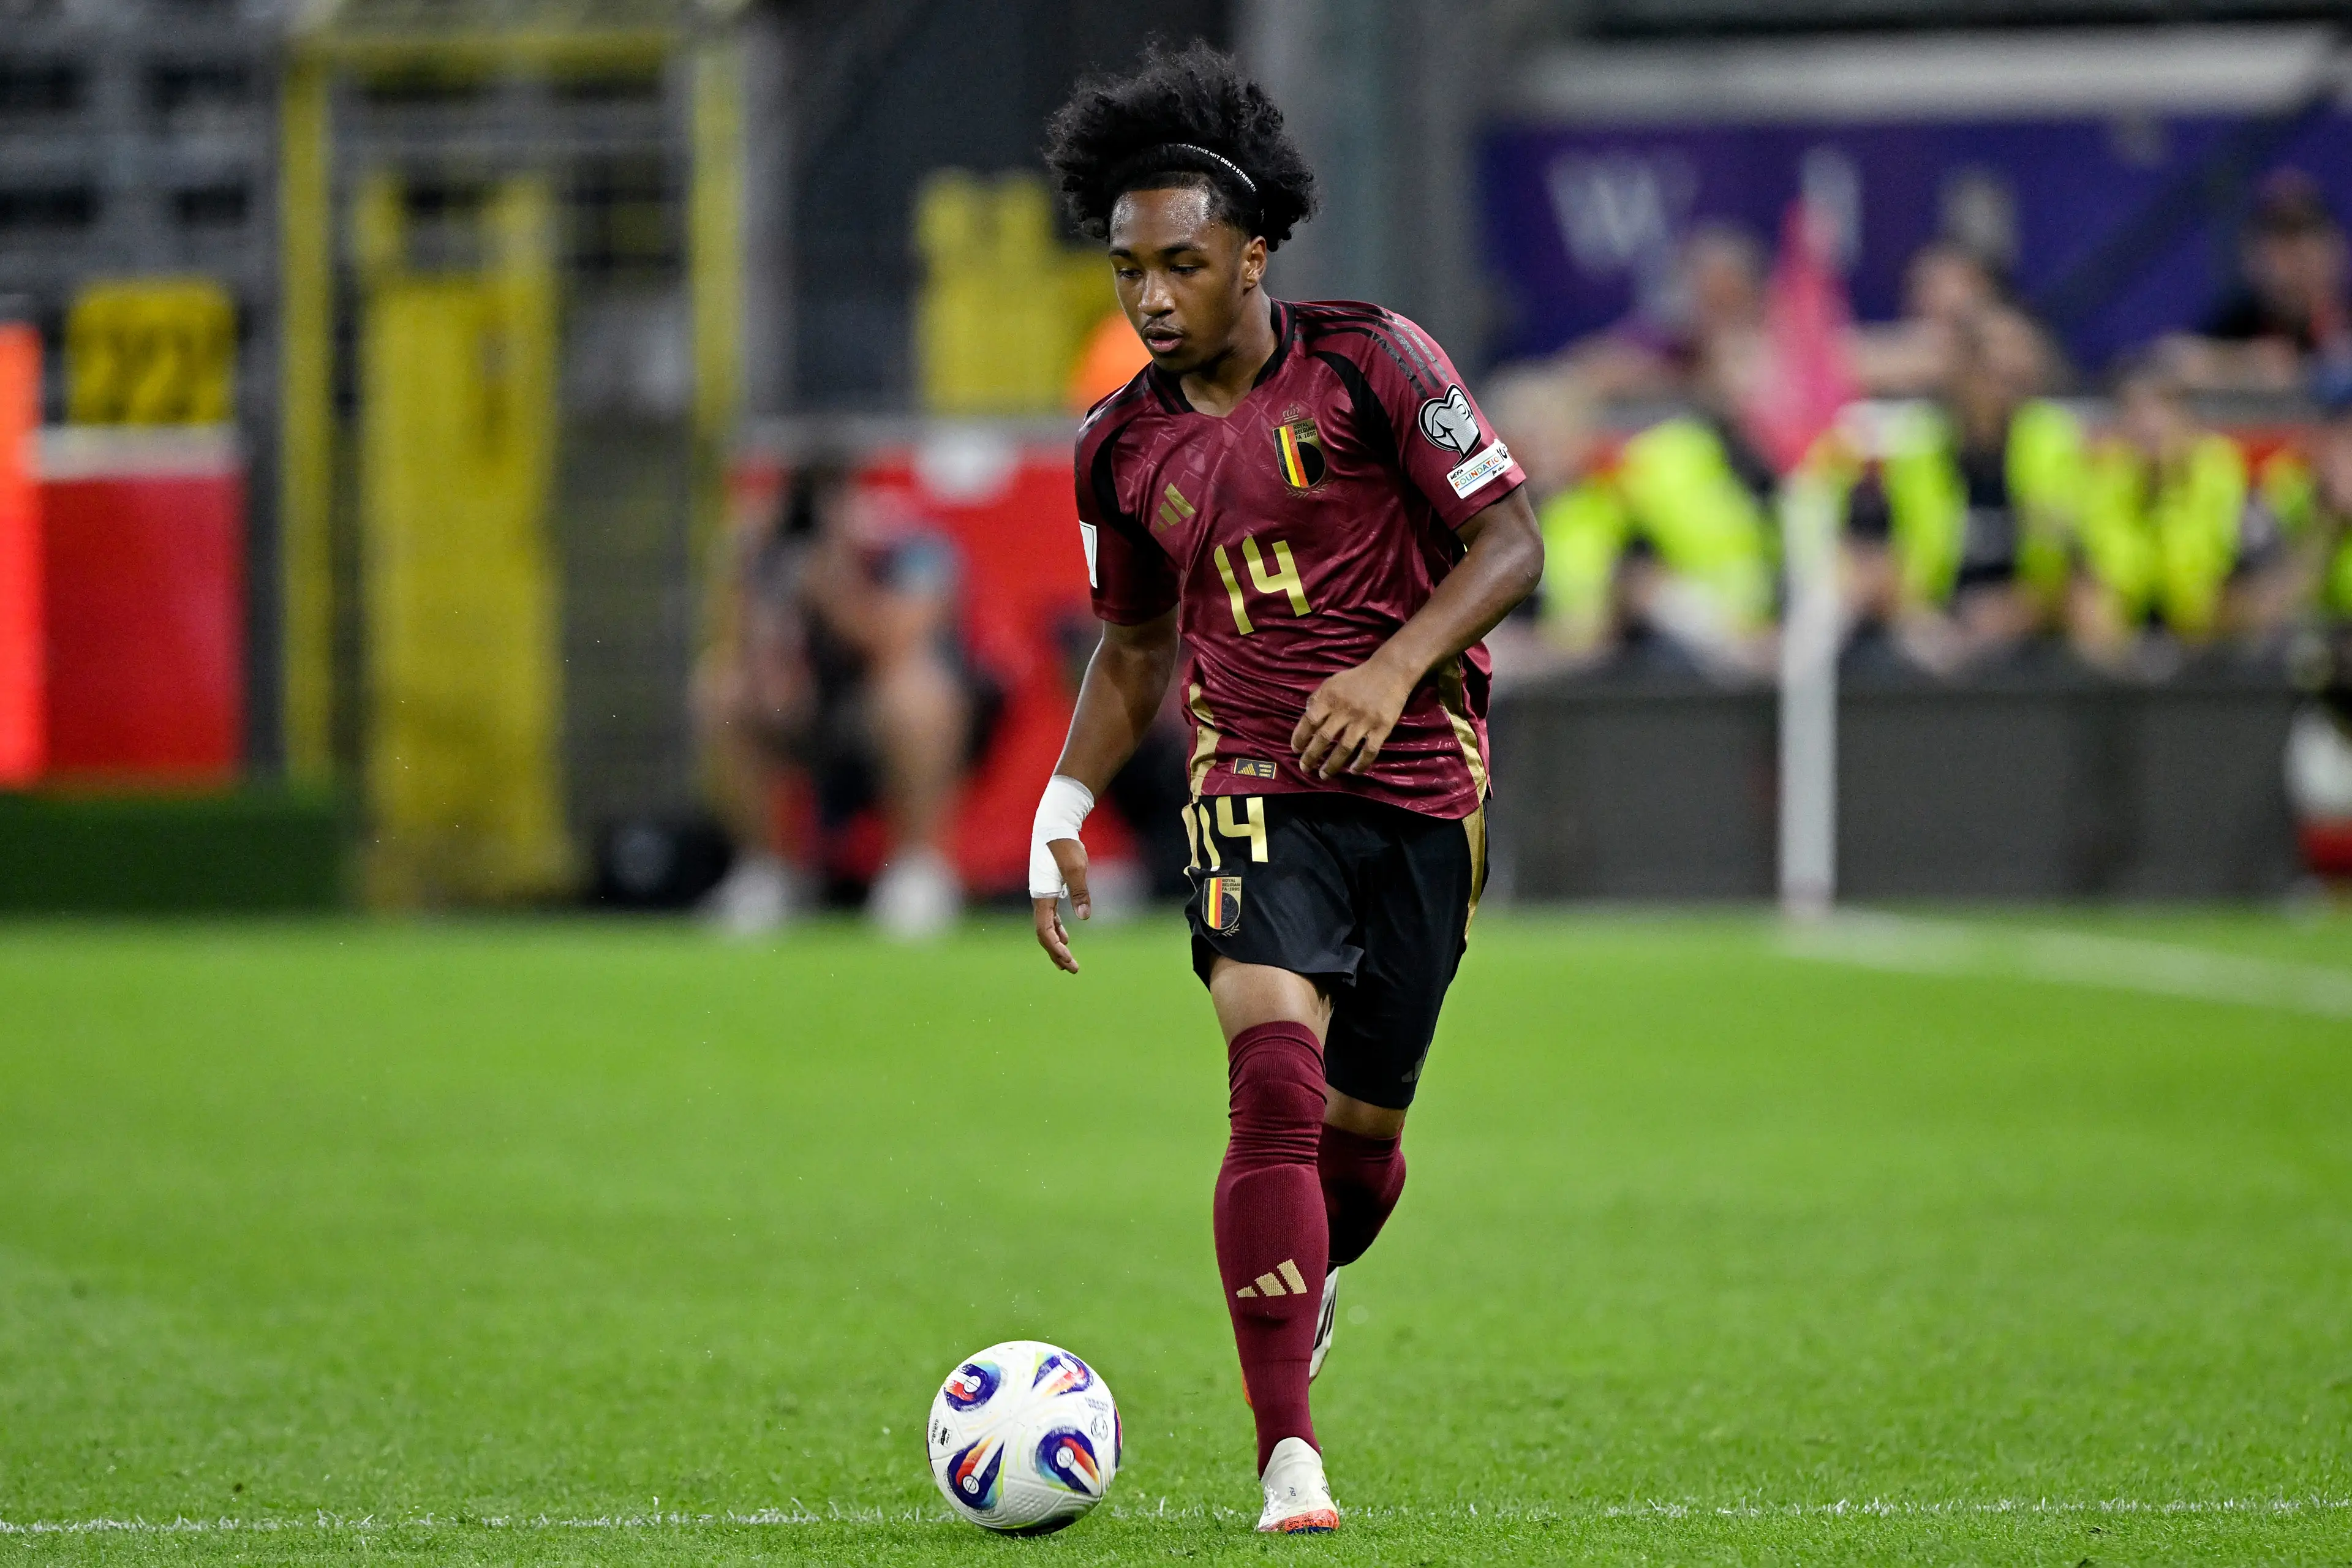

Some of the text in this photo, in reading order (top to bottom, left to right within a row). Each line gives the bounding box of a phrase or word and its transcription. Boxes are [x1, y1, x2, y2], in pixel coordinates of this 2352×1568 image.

[1188, 145, 1209, 154] MARKE
[1220, 157, 1233, 168] DEN
[1235, 168, 1257, 192] STREIFEN
[1294, 426, 1316, 435] BELGIAN
[1450, 469, 1464, 480] UEFA
[1213, 535, 1312, 636] 14
[1199, 796, 1268, 872] 14
